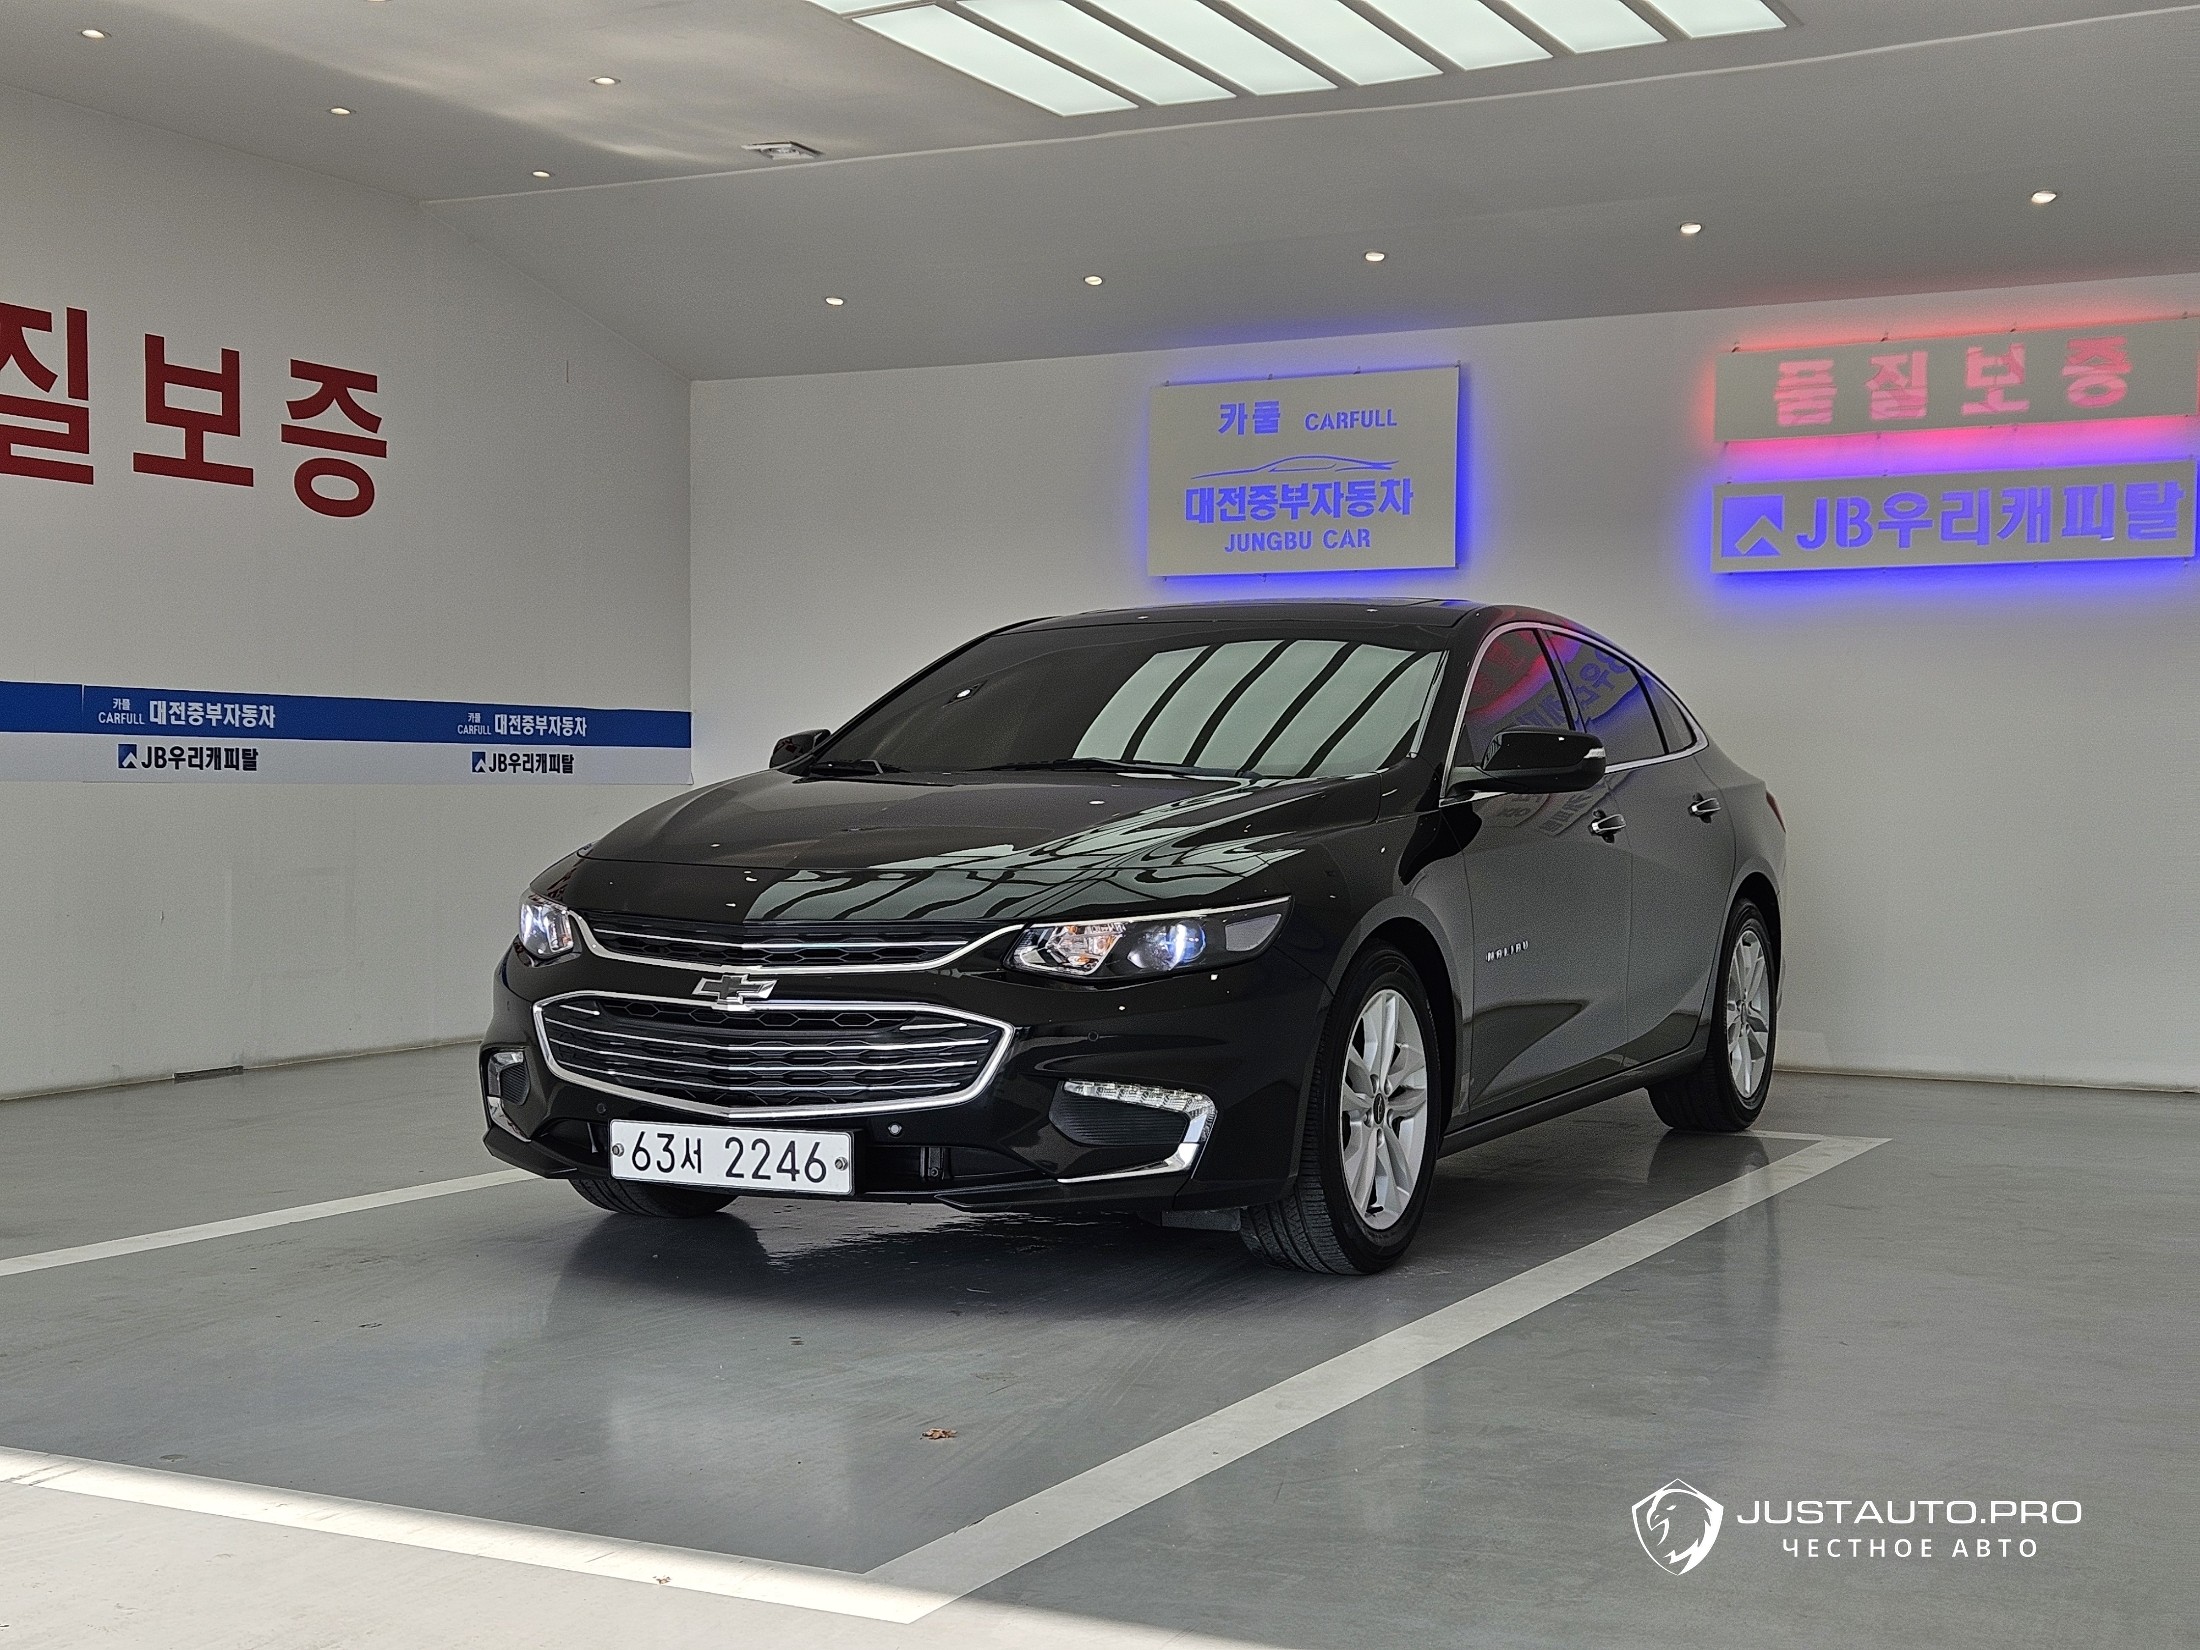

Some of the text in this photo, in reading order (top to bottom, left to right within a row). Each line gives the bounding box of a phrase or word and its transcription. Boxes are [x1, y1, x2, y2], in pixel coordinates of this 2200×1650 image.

[1304, 408, 1398, 431] CARFULL
[1184, 477, 1414, 524] 대전중부자동차
[1795, 480, 2186, 550] JB우리캐피탈
[1224, 528, 1371, 553] JUNGBU CAR
[98, 711, 145, 725] CARFULL
[149, 700, 276, 729] 대전중부자동차
[494, 713, 588, 737] 대전중부자동차
[457, 724, 492, 735] CARFULL
[140, 745, 259, 772] JB우리캐피탈
[488, 752, 575, 775] JB우리캐피탈
[631, 1131, 827, 1183] 63서 2246
